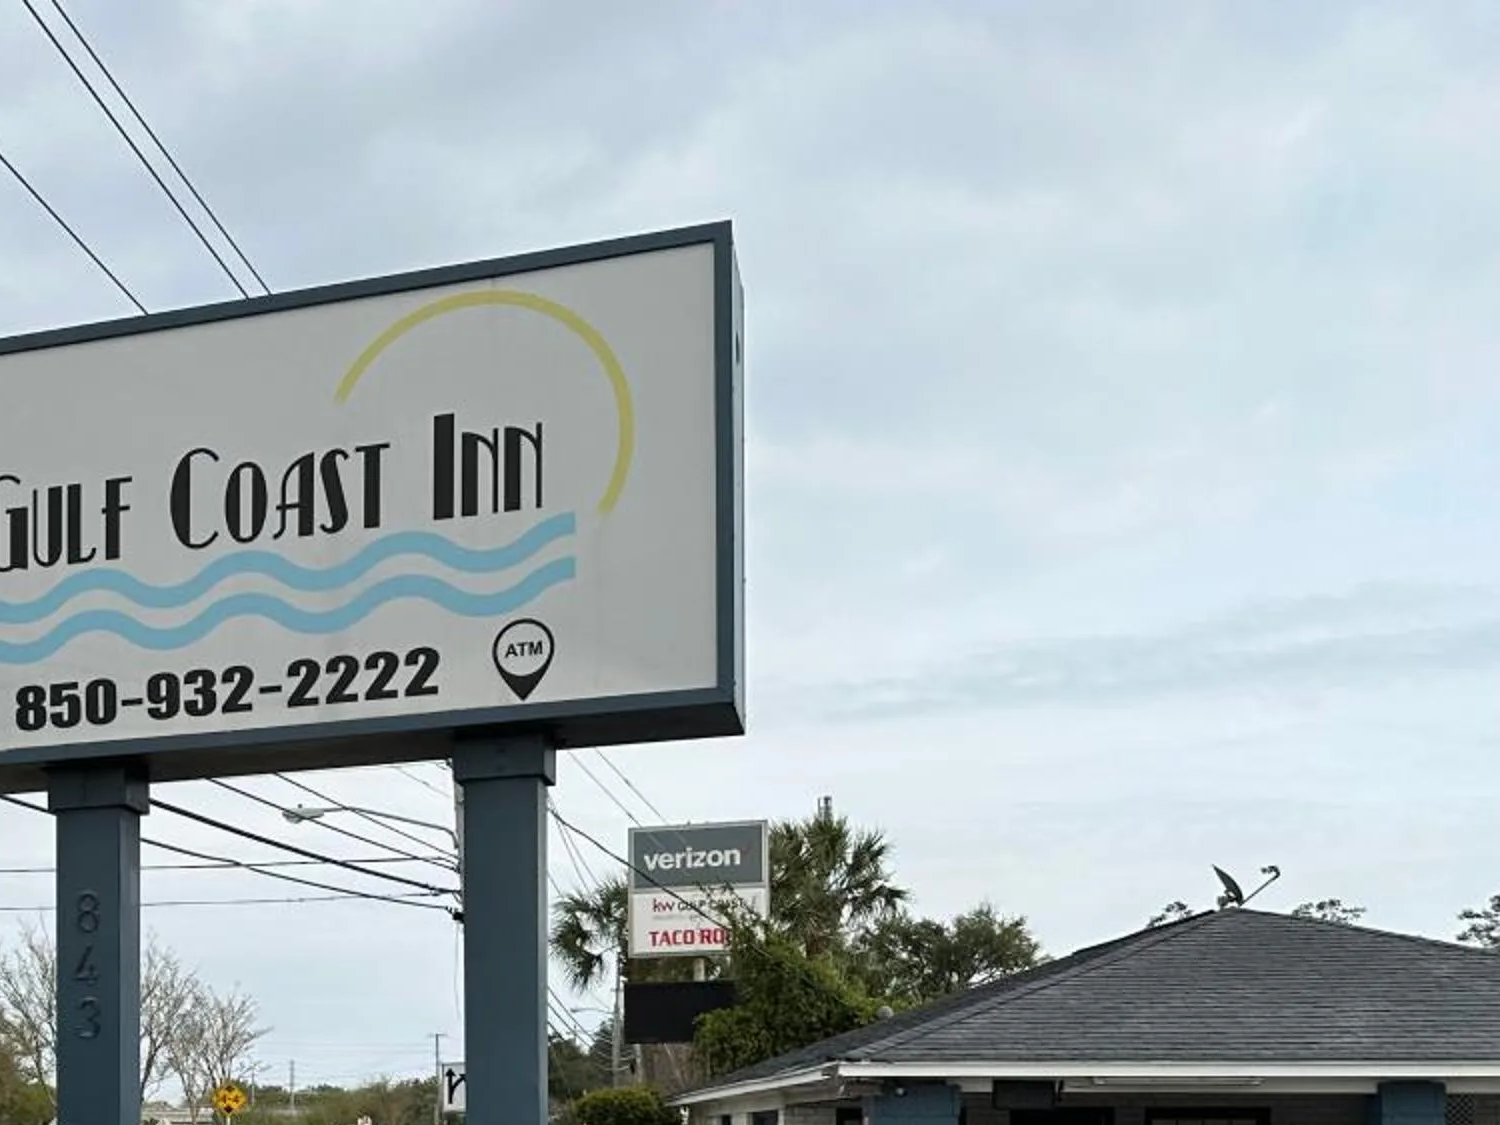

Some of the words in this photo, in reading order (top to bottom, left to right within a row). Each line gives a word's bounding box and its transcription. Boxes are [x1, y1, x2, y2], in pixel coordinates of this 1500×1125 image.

[170, 443, 390, 549] COAST
[505, 640, 543, 658] ATM
[15, 646, 440, 731] 850-932-2222
[643, 847, 741, 871] verizon
[648, 929, 696, 947] TACO
